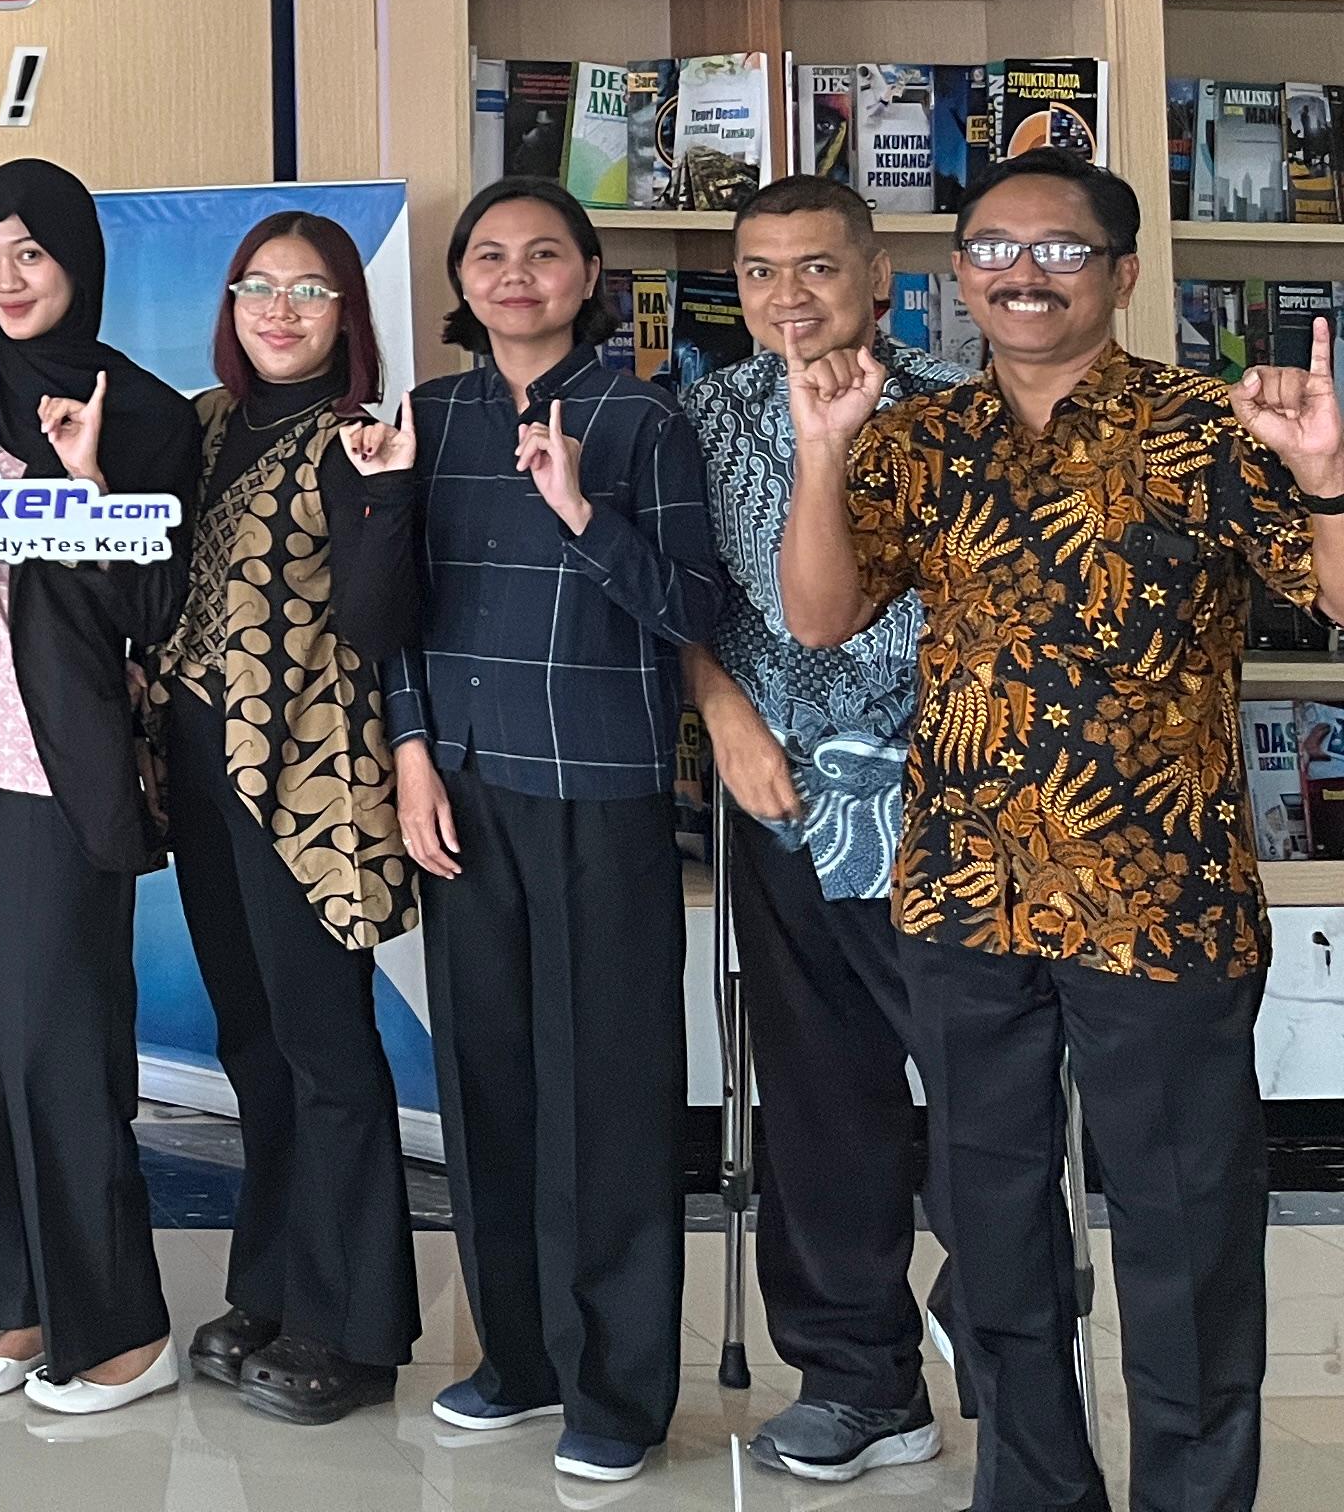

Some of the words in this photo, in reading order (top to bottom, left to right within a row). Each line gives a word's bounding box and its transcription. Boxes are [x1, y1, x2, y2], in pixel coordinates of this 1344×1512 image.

[9, 53, 40, 120] !
[1007, 72, 1056, 88] STRUKTUR
[1057, 73, 1081, 89] DATA
[1019, 88, 1075, 99] ALGORITMA
[1223, 88, 1273, 106] ANALISIS
[715, 106, 749, 120] Desain
[873, 134, 930, 149] AKUNTAN
[867, 171, 932, 187] PERUSAHA
[1279, 295, 1309, 309] SUPPLY
[95, 537, 165, 556] Kerja
[1254, 722, 1298, 754] DAS
